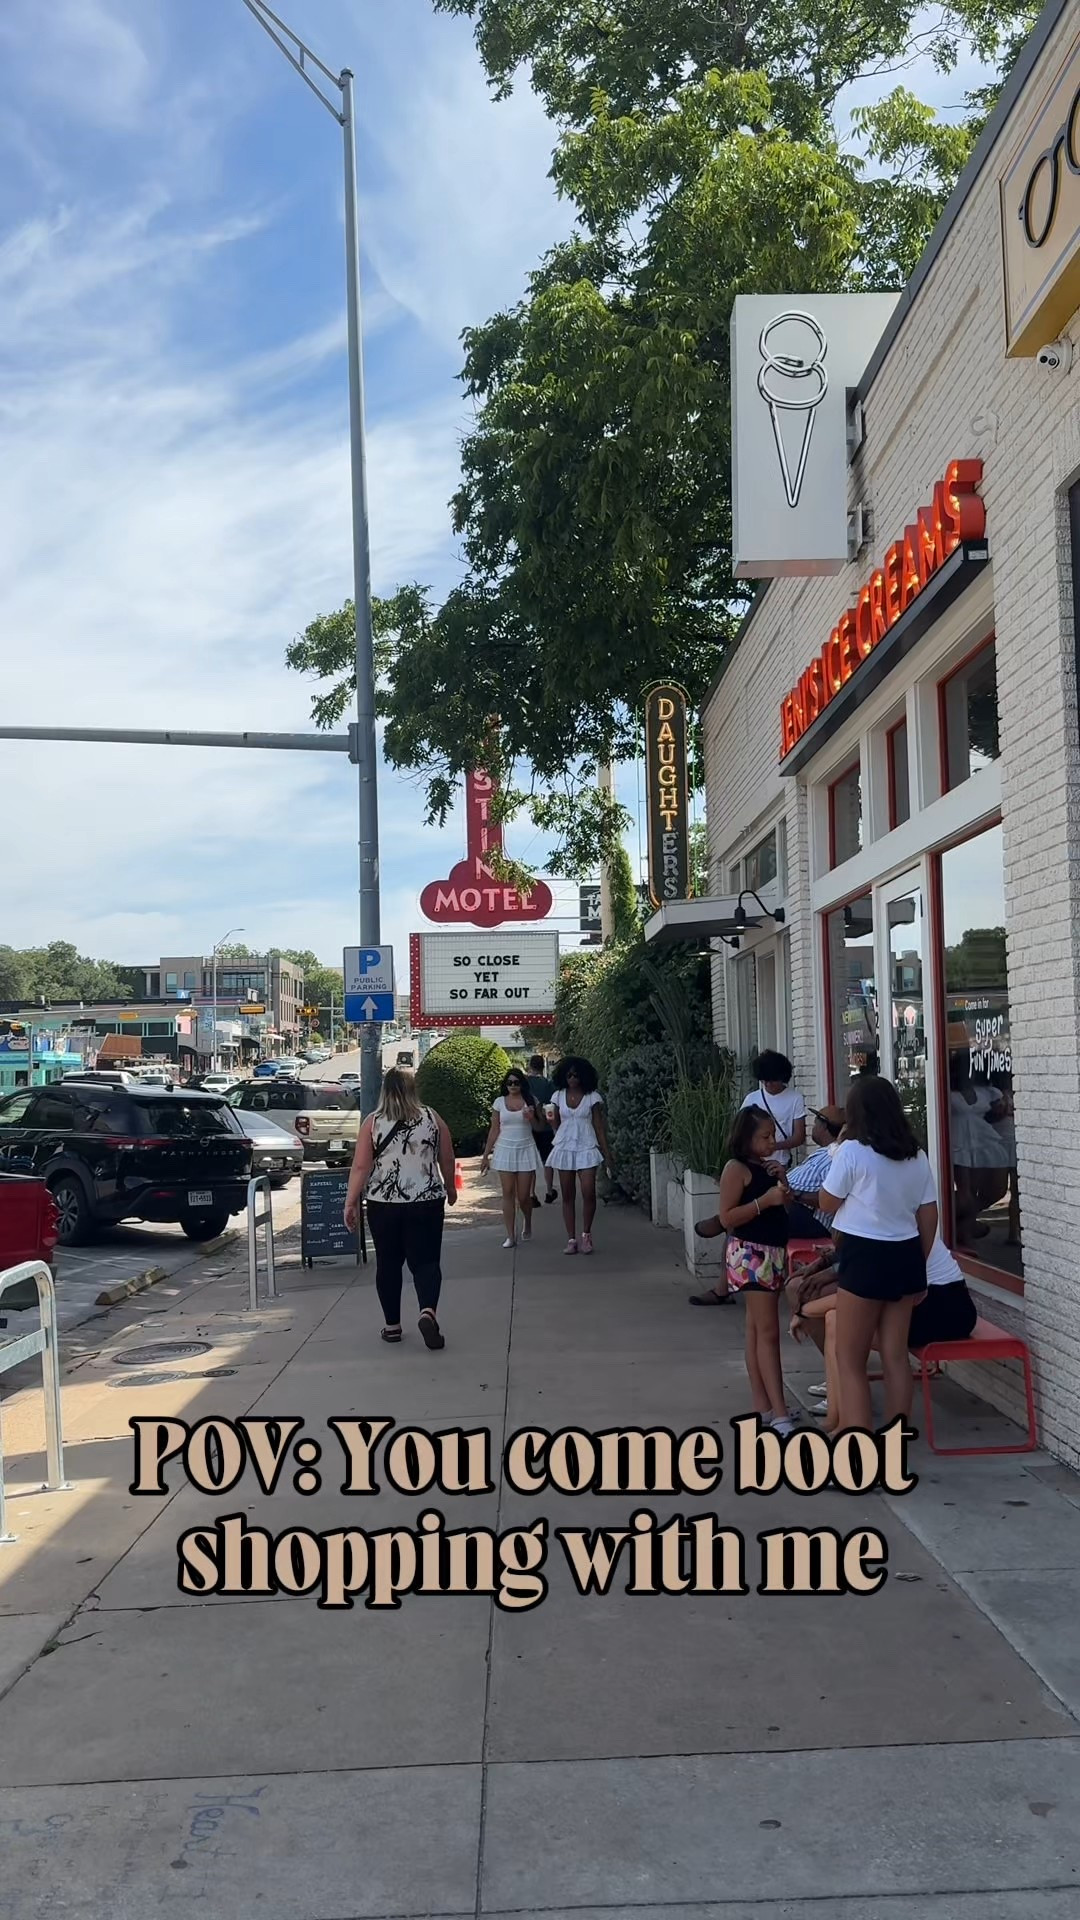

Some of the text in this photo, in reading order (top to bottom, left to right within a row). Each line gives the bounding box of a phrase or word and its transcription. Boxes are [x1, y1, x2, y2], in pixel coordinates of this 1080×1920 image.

[822, 610, 856, 703] ICE
[856, 459, 986, 660] CREAMS
[658, 698, 680, 899] DAUGHTERS
[434, 887, 538, 912] MOTEL
[359, 949, 381, 975] P
[453, 955, 520, 967] SO CLOSE
[474, 971, 499, 983] YET
[350, 983, 387, 991] PARKING
[449, 987, 530, 1000] SO FAR OUT
[965, 1000, 977, 1010] Come
[982, 997, 990, 1008] for
